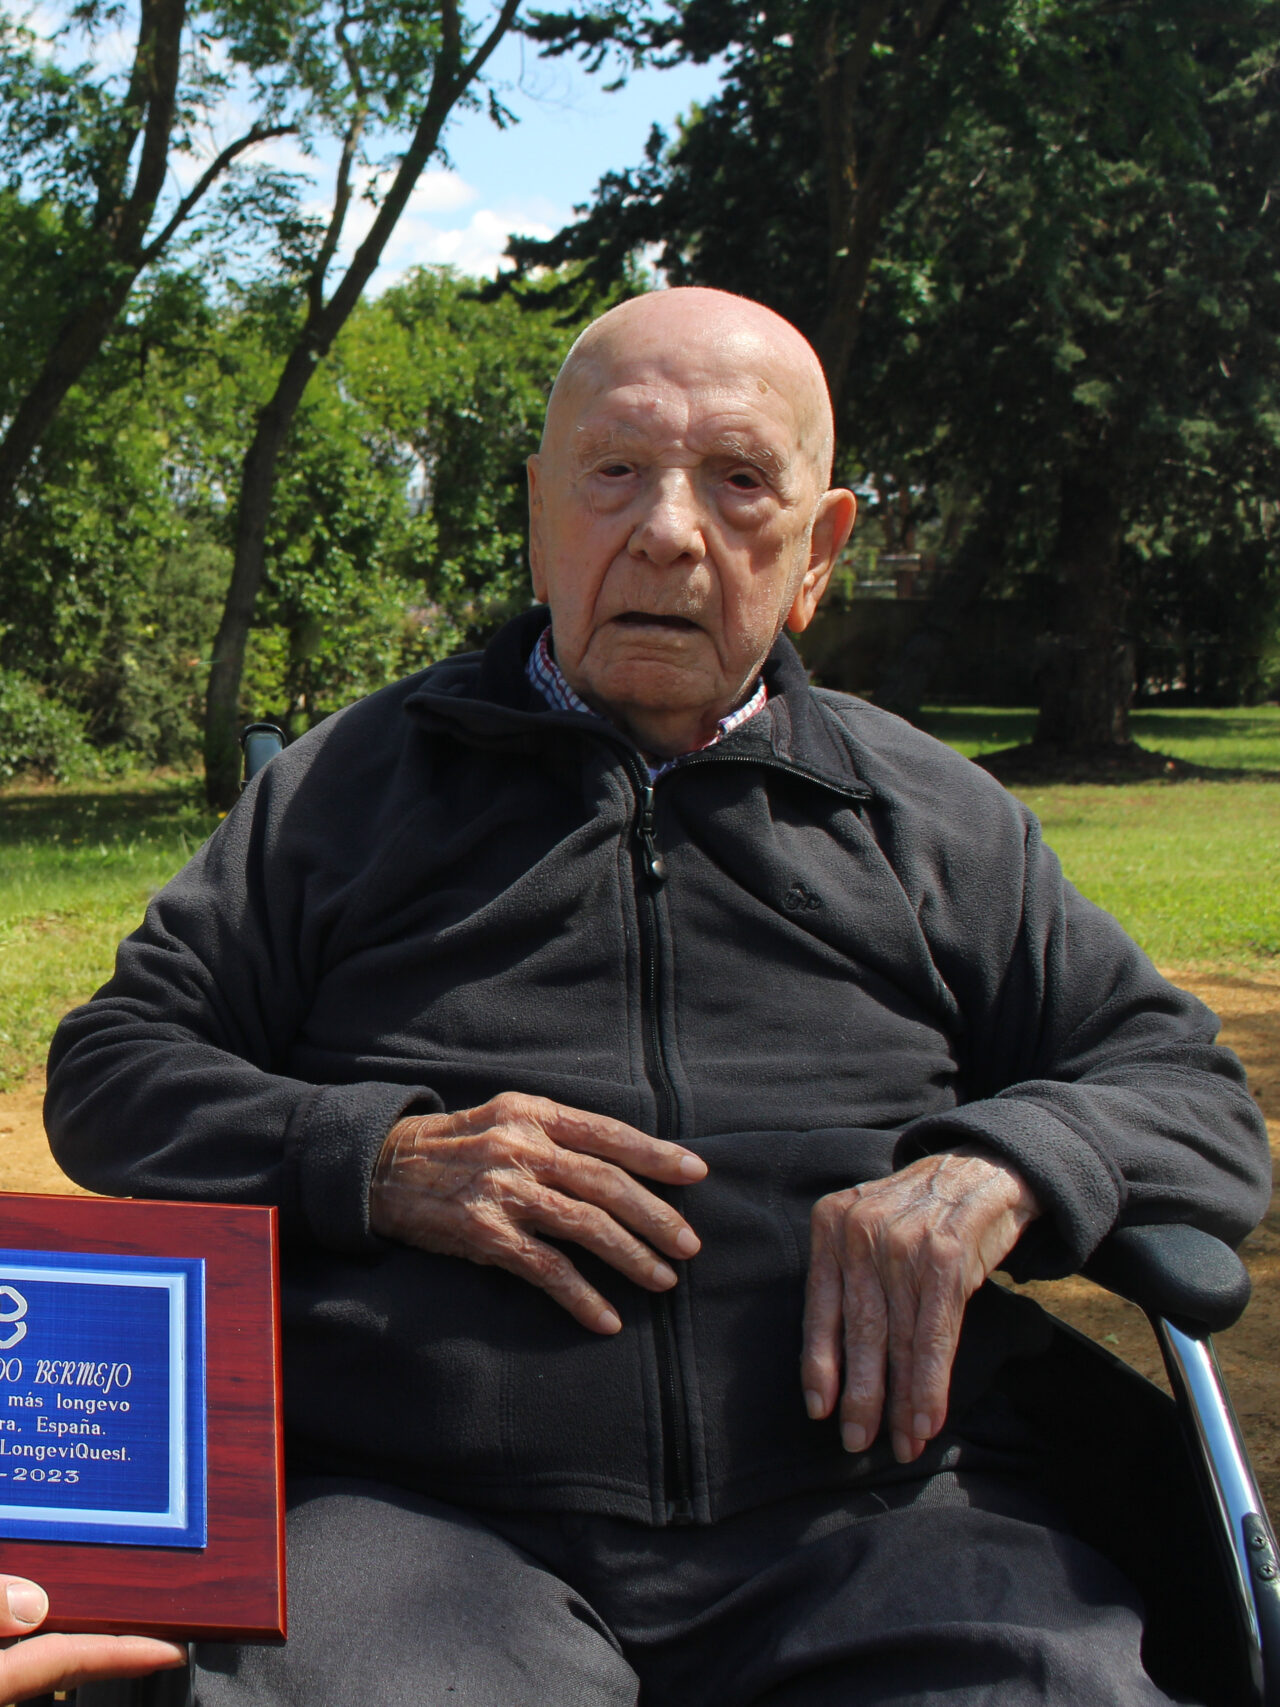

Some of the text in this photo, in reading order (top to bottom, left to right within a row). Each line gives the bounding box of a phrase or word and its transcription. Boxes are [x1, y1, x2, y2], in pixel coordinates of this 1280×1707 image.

[33, 1359, 132, 1395] BERMEJO
[7, 1391, 44, 1408] más
[56, 1392, 130, 1415] longevo
[36, 1415, 106, 1438] España.
[0, 1438, 132, 1462] LongeviQuest.
